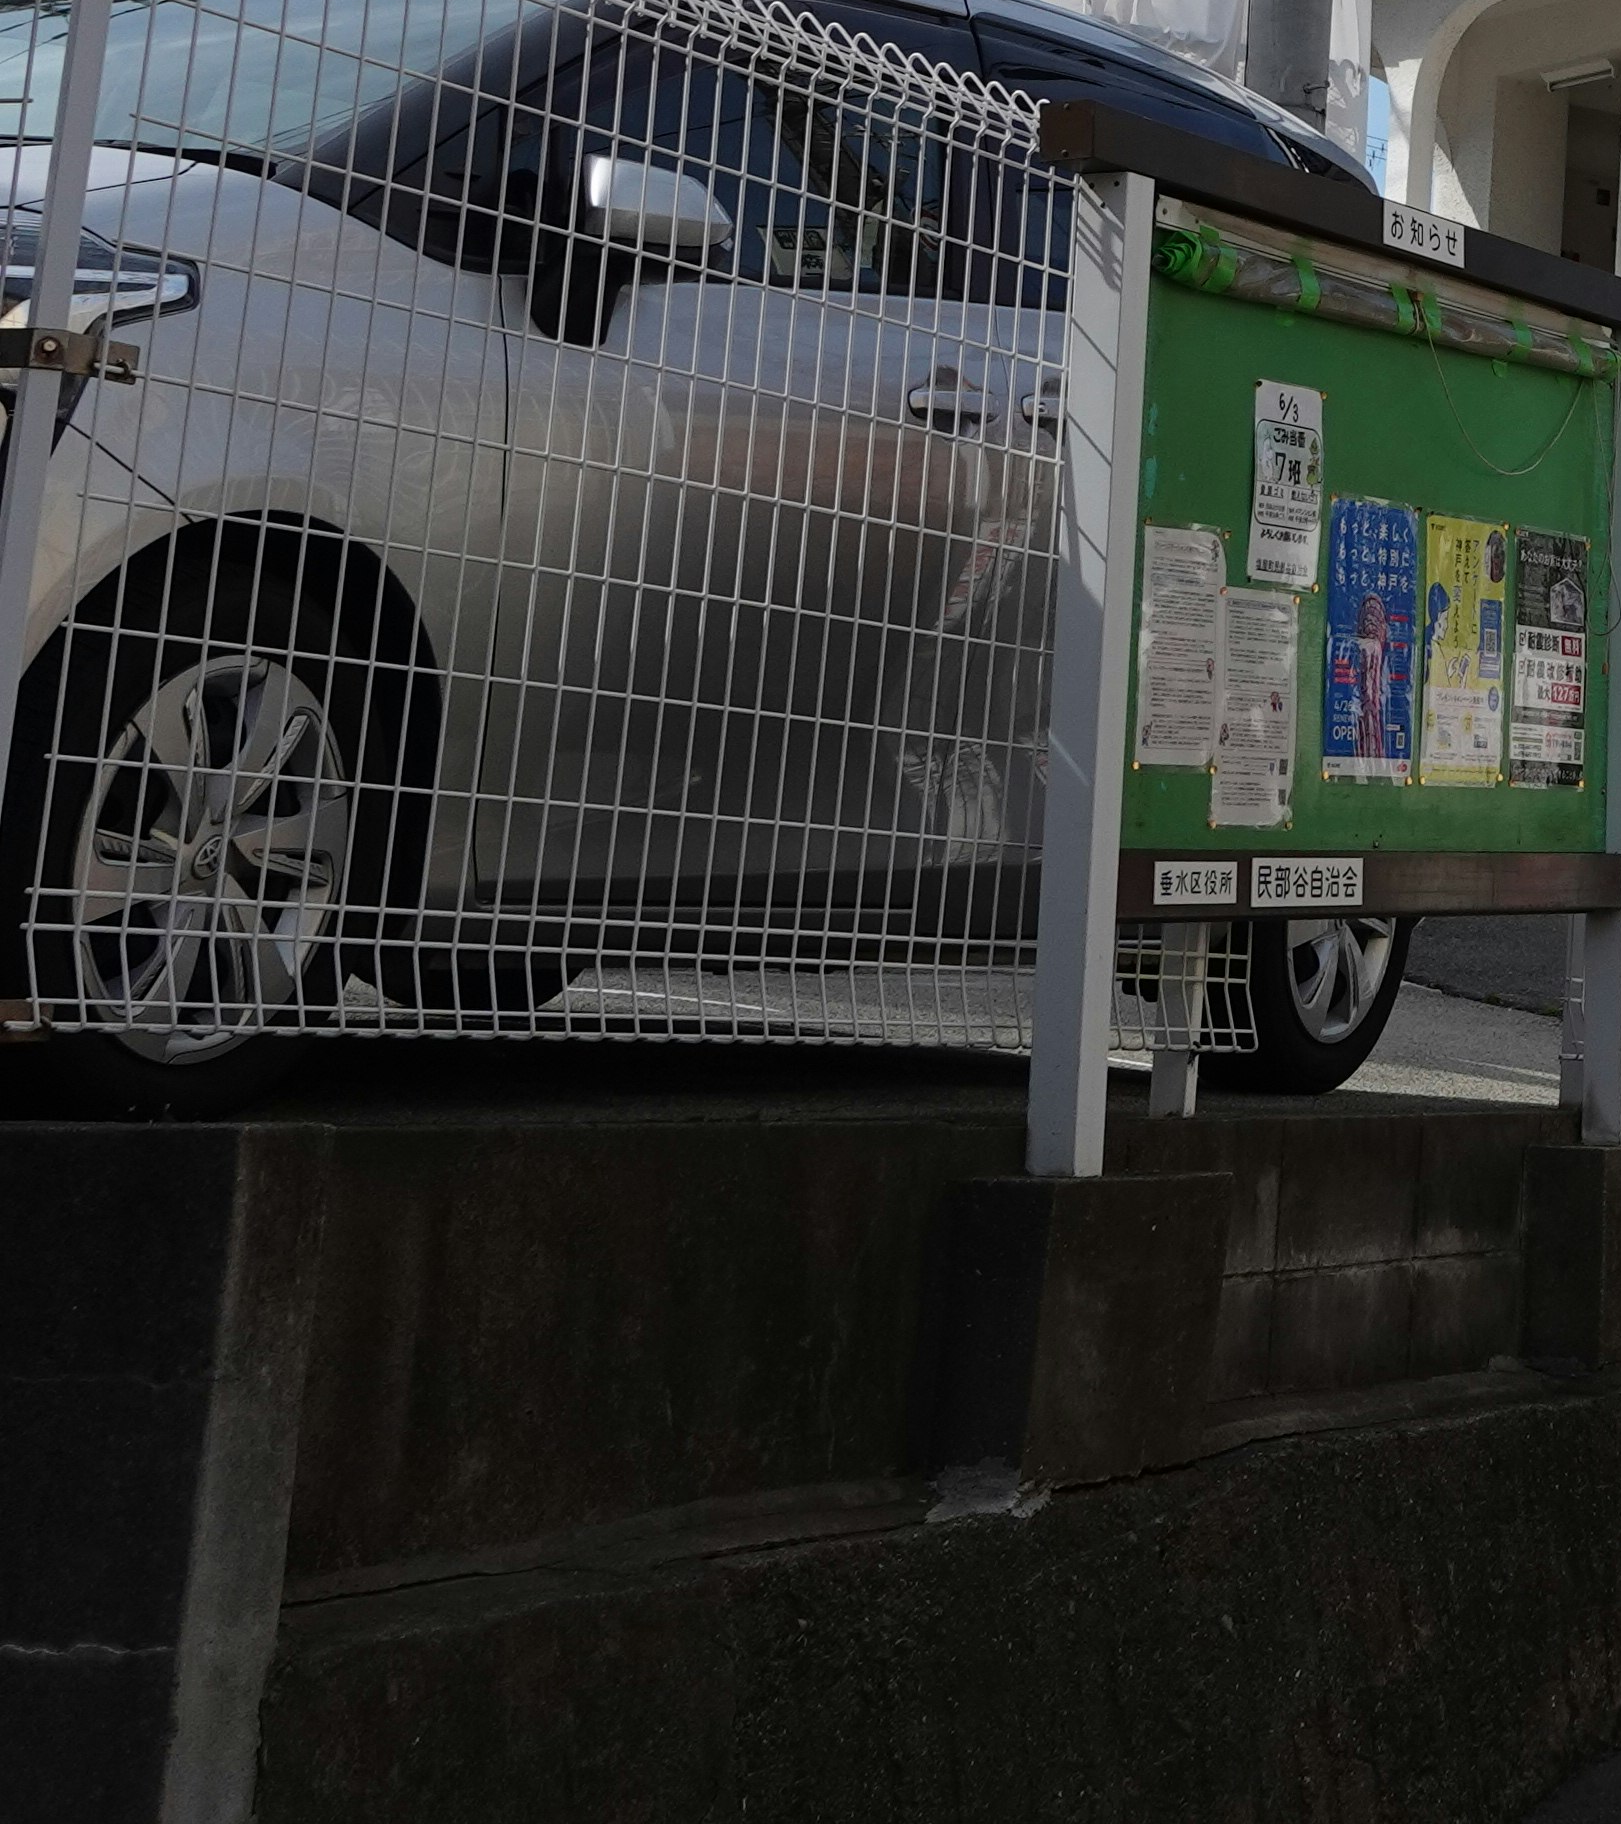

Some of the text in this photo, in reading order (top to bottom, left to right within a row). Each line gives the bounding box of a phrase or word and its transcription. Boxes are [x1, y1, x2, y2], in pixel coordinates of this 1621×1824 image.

[1391, 210, 1458, 256] お知らせ
[1279, 392, 1299, 423] 6/3
[1332, 725, 1359, 741] OPEN
[1160, 869, 1233, 896] 垂水区役所
[1257, 865, 1358, 900] 民部谷自治会
